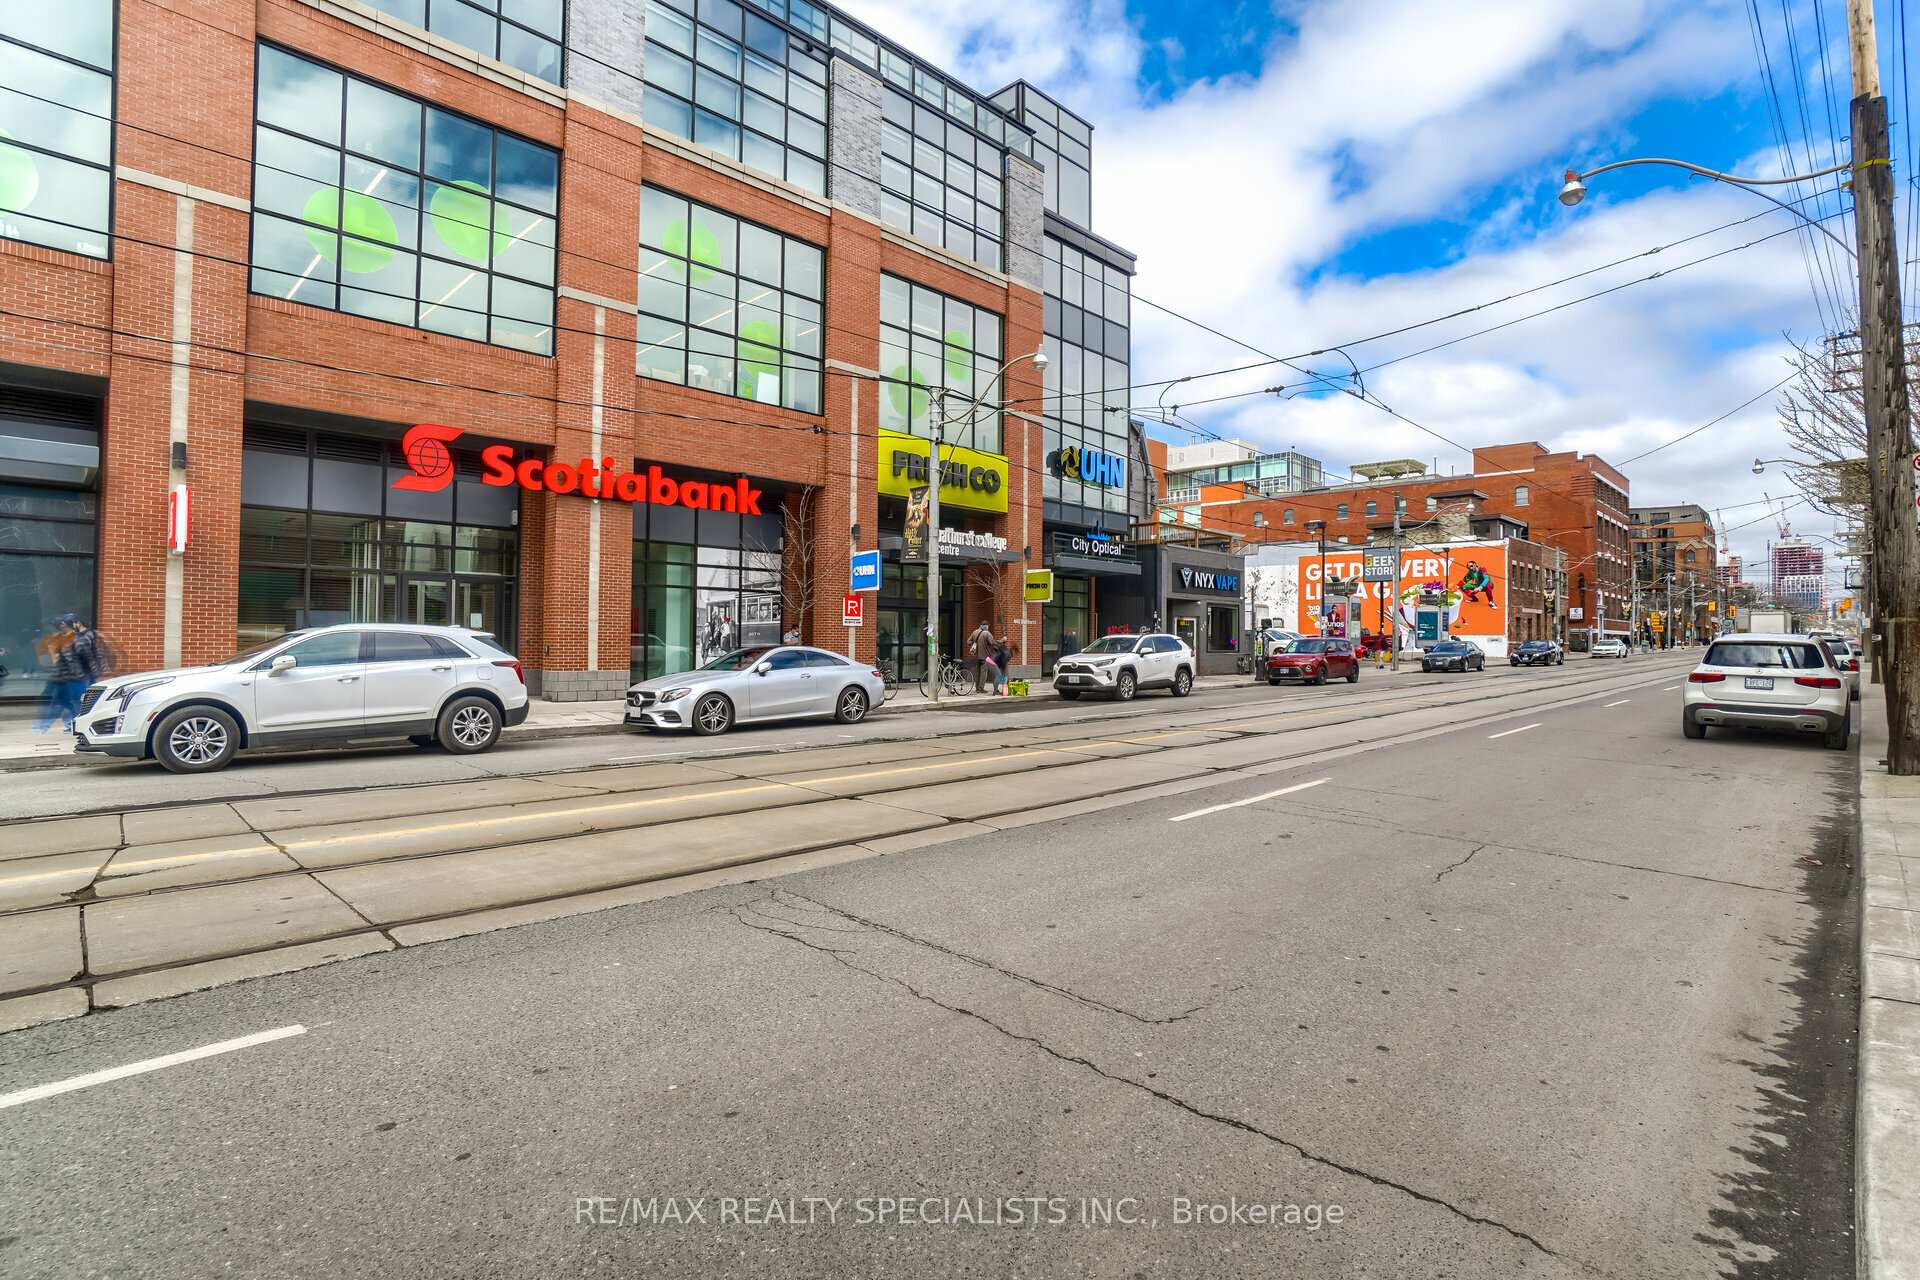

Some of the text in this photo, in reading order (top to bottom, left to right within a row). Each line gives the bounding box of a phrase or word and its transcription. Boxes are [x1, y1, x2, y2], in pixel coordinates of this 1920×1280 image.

[481, 444, 762, 517] Scotiabank
[1080, 447, 1125, 489] UHN
[1072, 537, 1121, 556] City Optical
[1195, 571, 1238, 591] NYX VAPE
